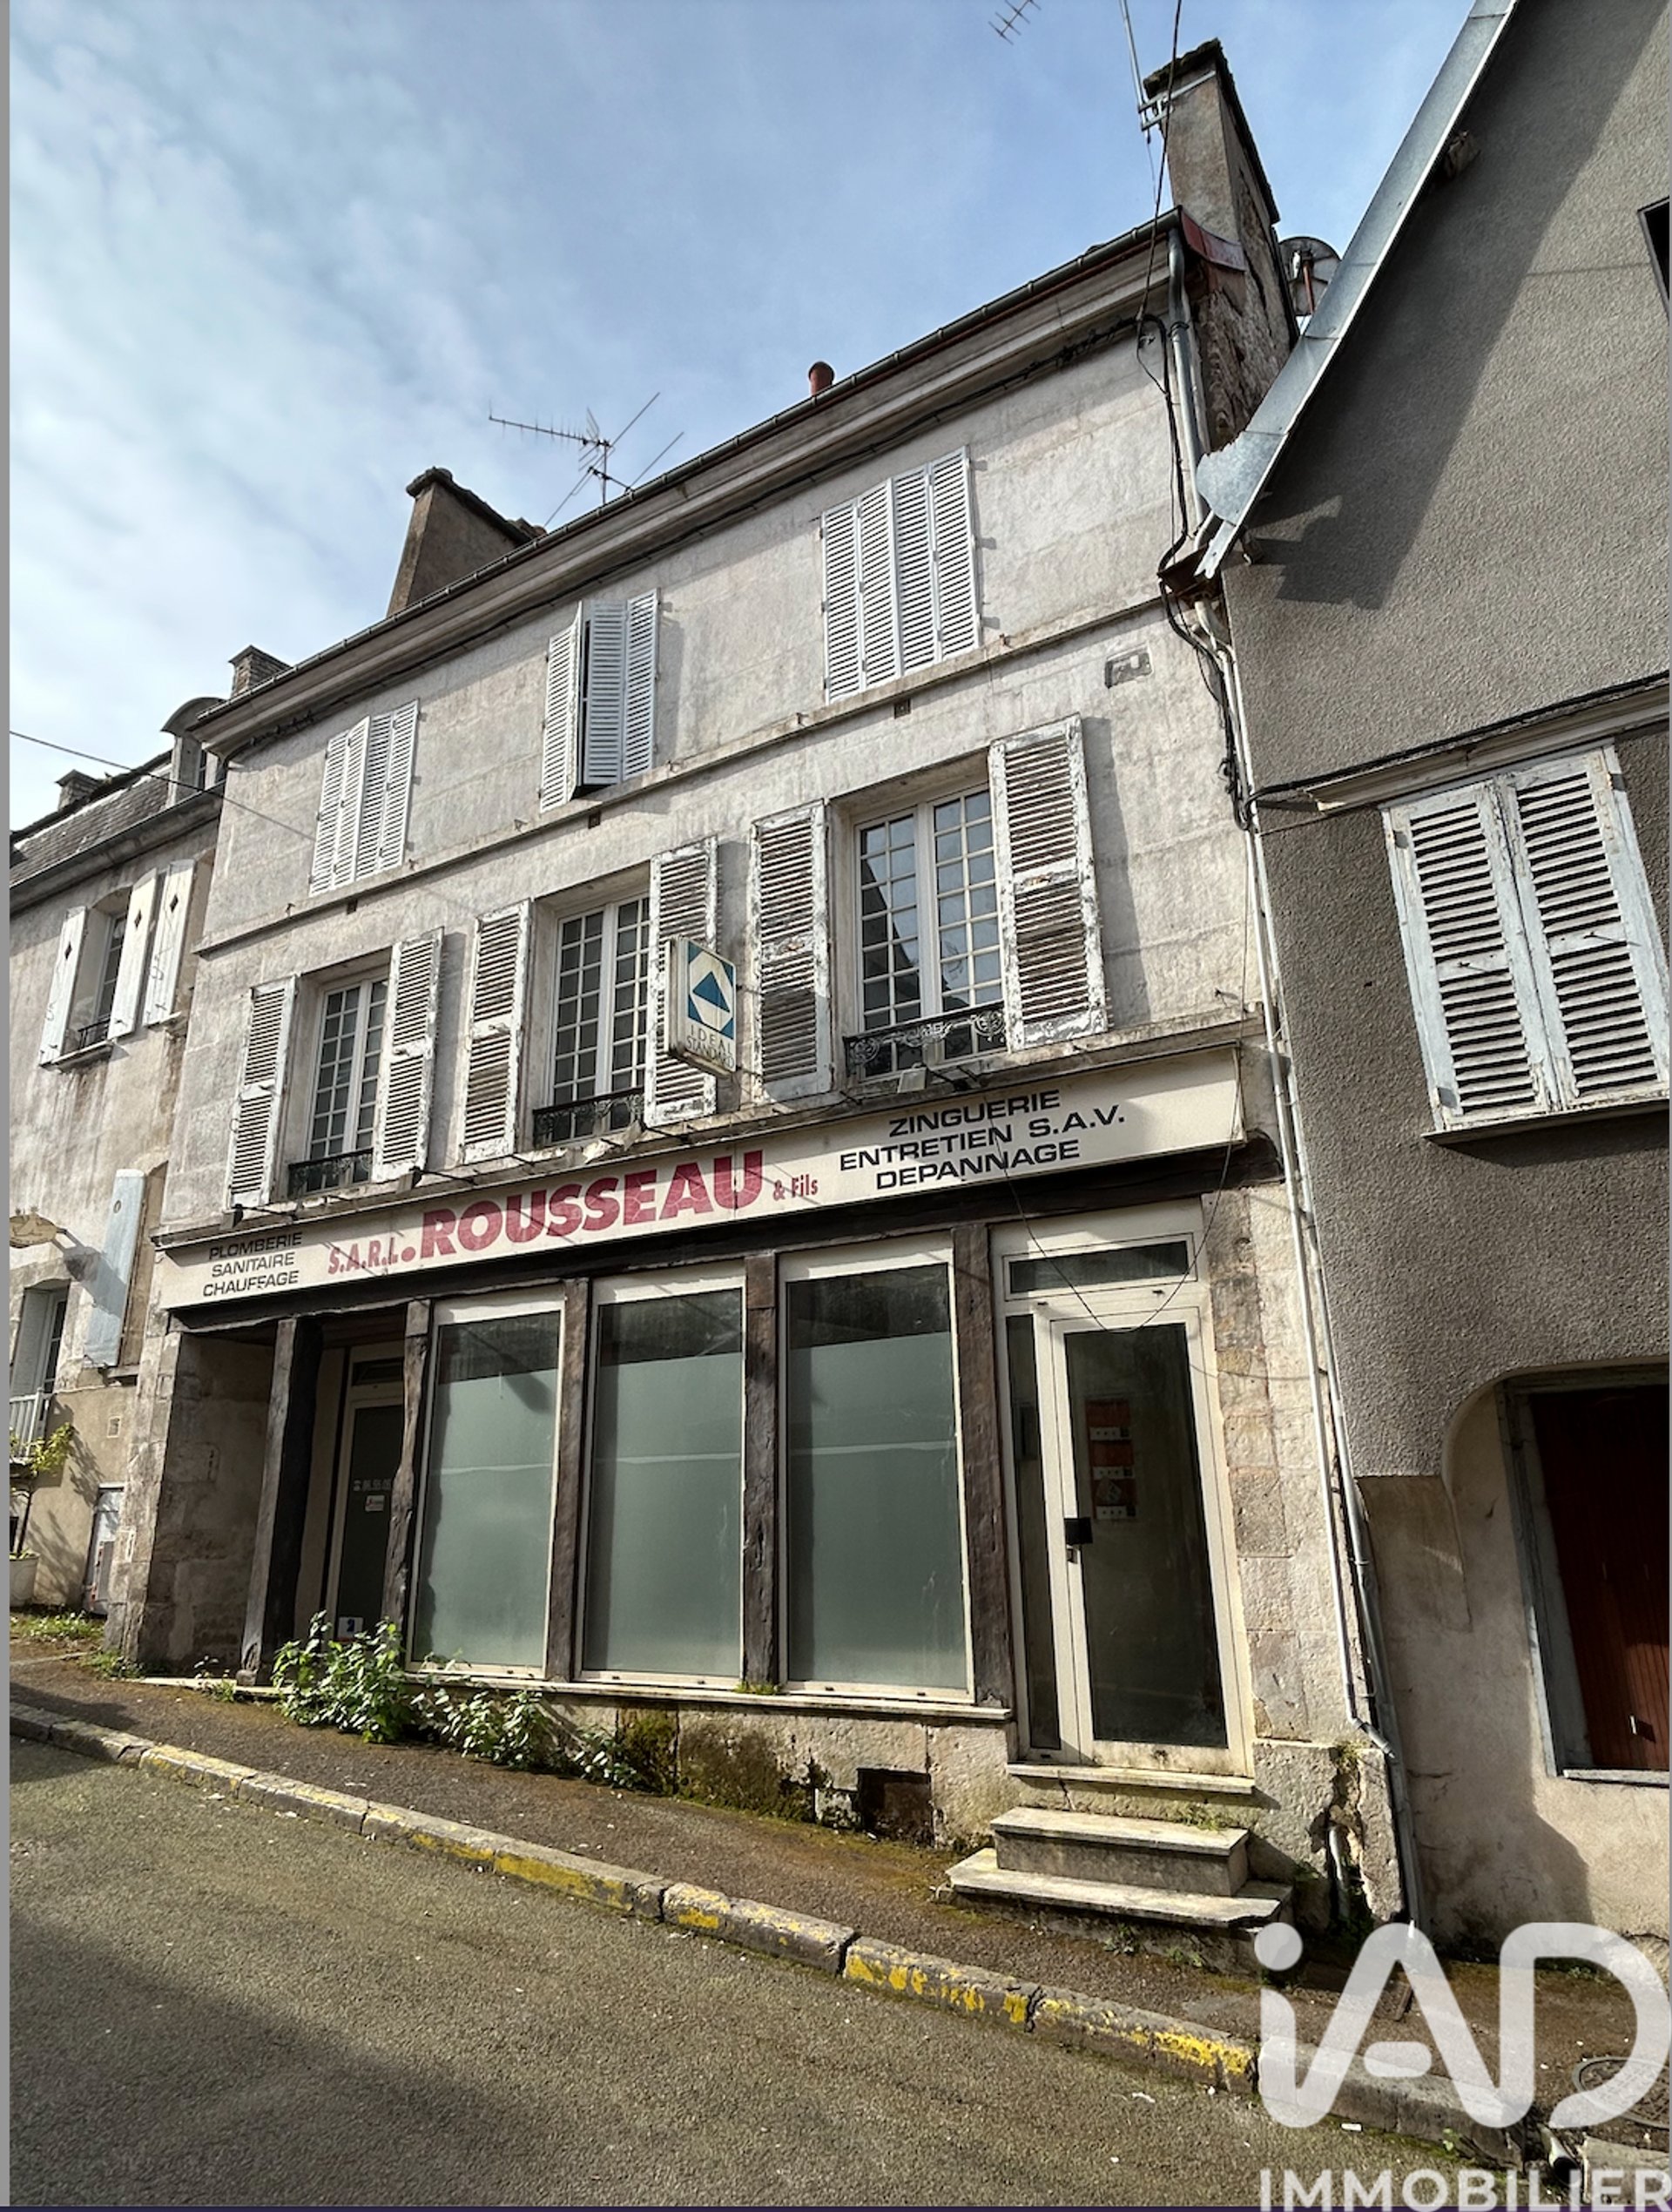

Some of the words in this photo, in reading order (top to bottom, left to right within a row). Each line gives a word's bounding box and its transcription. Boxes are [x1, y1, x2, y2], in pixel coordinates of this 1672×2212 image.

[690, 1023, 733, 1056] IDEAL
[888, 1089, 1061, 1137] ZINGUERIE
[839, 1124, 1013, 1171] ENTRETIEN
[1028, 1104, 1125, 1138] S.A.V.
[876, 1139, 1080, 1190] DEPANNAGE
[420, 1150, 763, 1259] ROUSSEAU
[772, 1179, 785, 1201] &
[791, 1173, 819, 1198] Fils
[208, 1231, 302, 1261] PLOMBERIE
[211, 1251, 295, 1278] SANITAIRE
[202, 1270, 300, 1298] CHAUFFAGE
